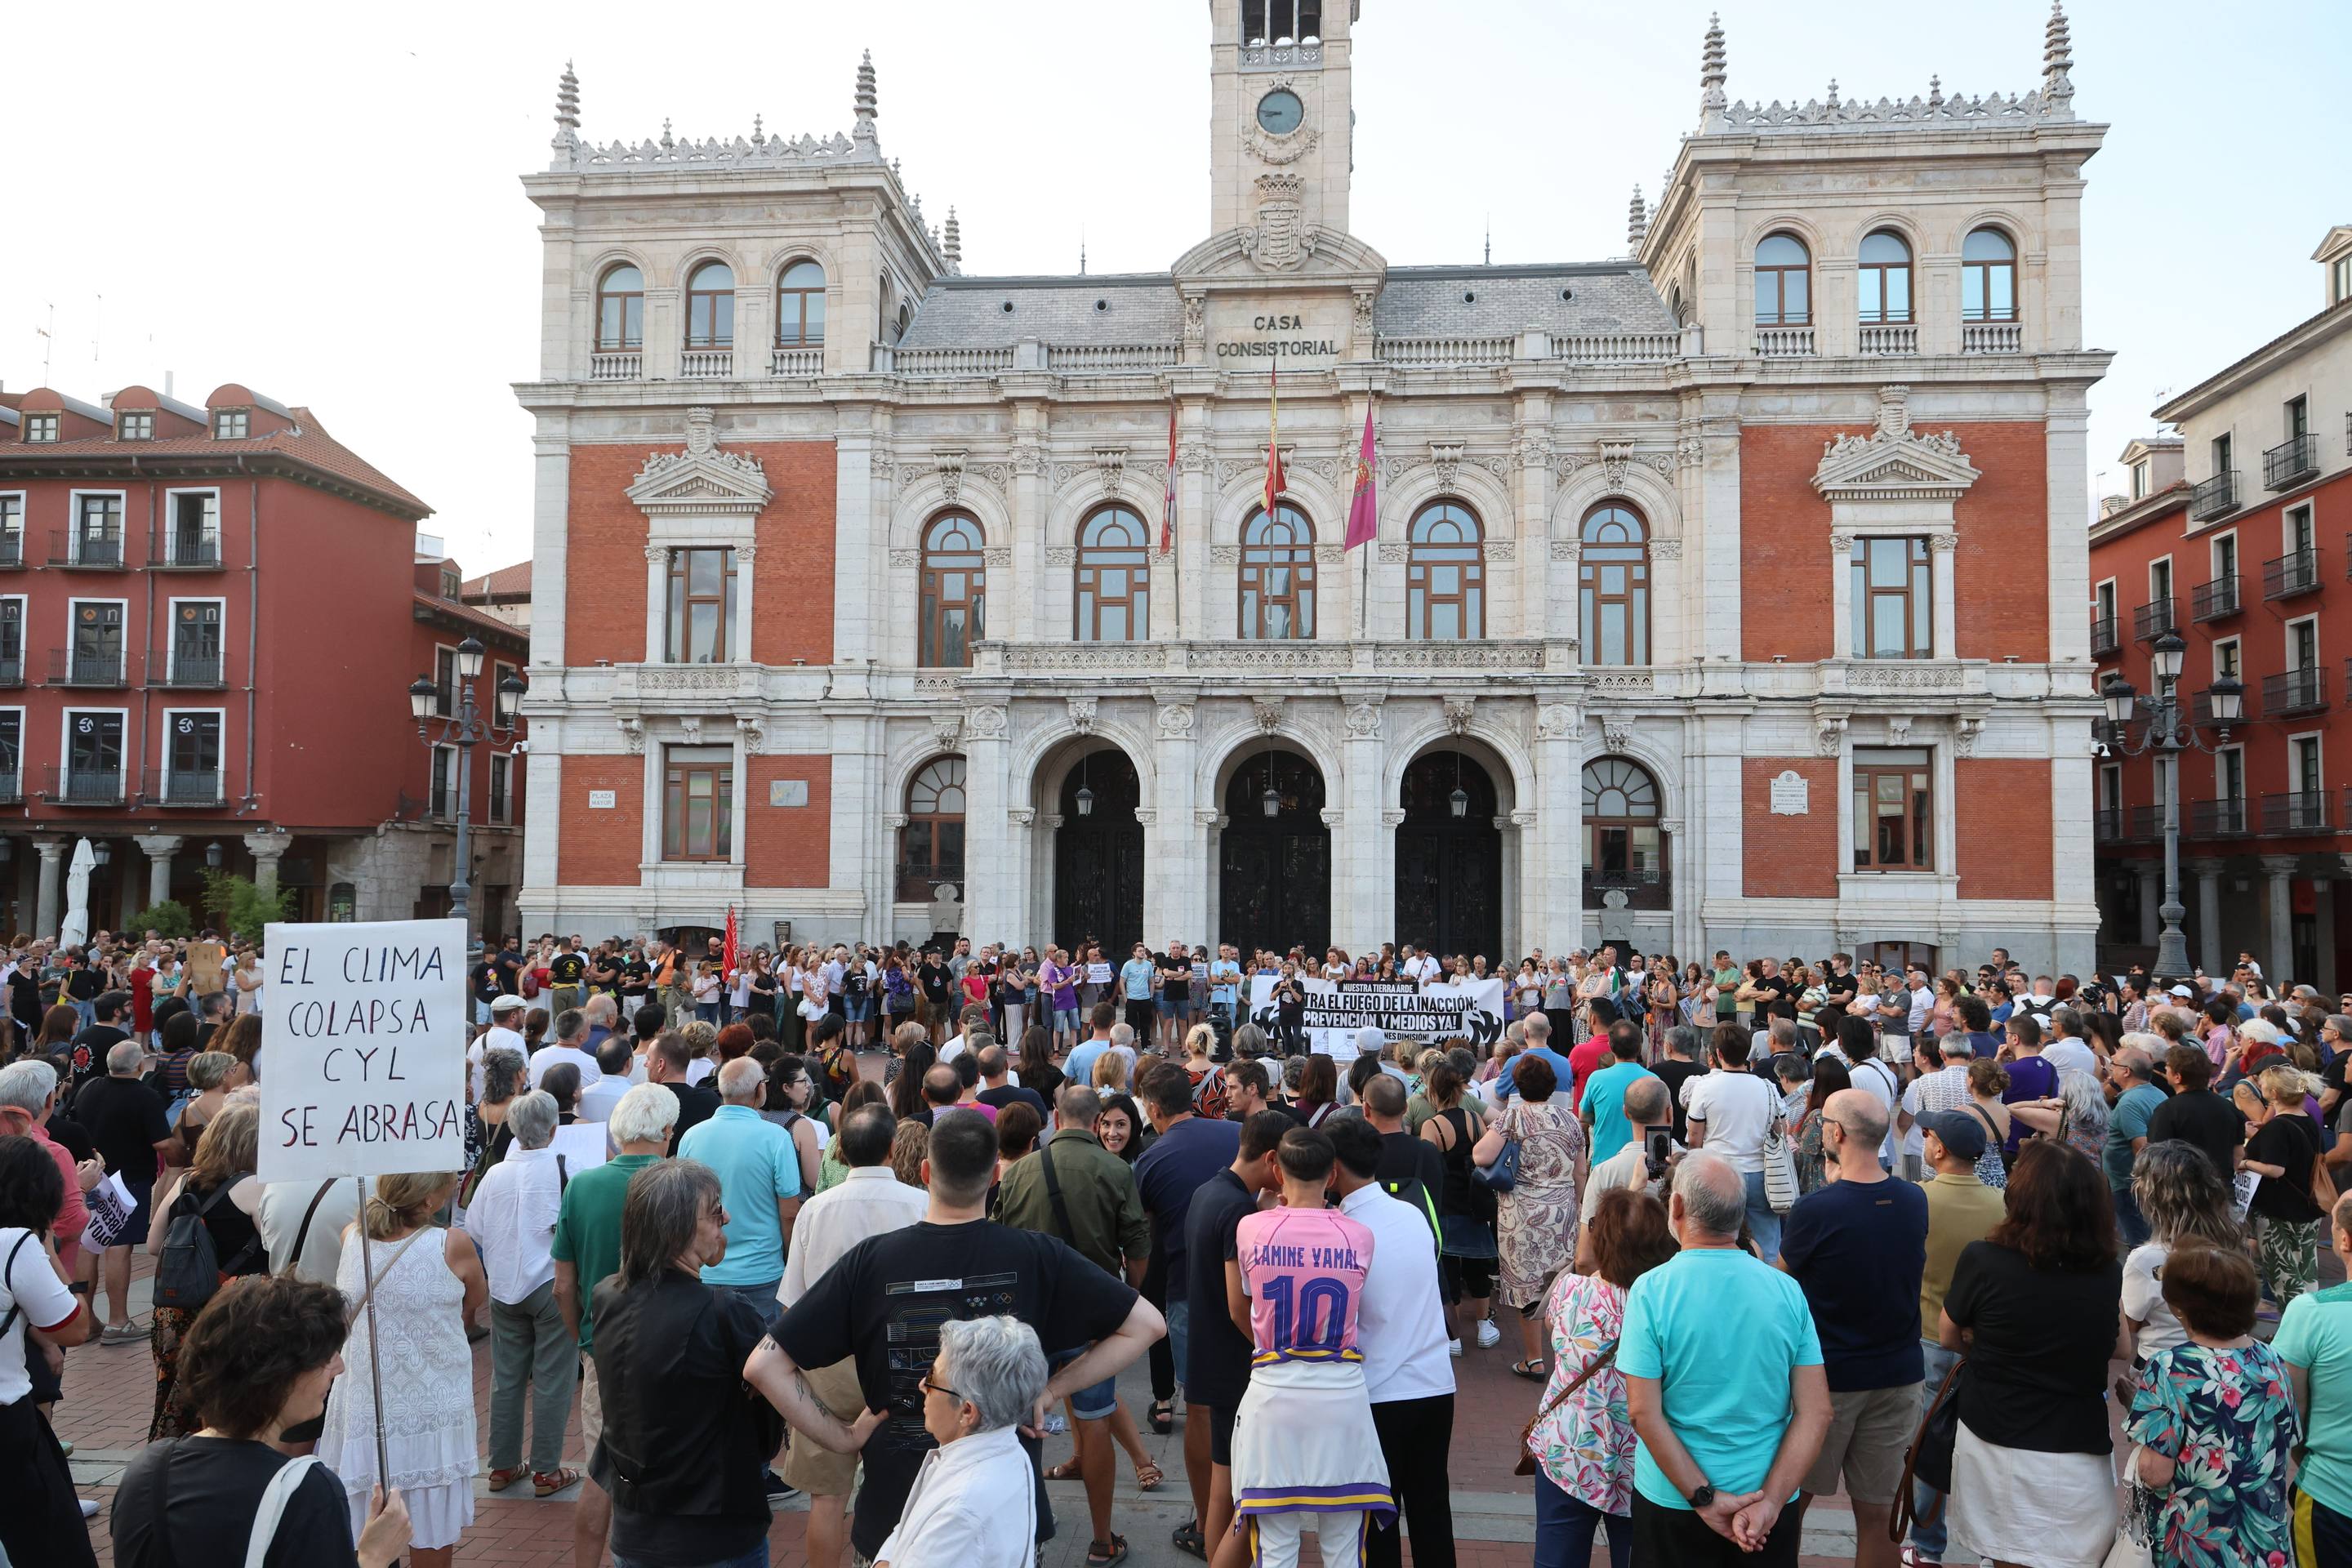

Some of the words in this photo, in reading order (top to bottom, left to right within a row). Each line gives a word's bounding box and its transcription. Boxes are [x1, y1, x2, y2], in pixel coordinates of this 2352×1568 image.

[1254, 315, 1303, 330] CASA
[1217, 341, 1339, 357] CONSISTORIAL
[280, 947, 314, 984] EL
[343, 946, 443, 982] CLIMA
[1343, 983, 1373, 993] NUESTRA
[1373, 984, 1396, 993] TIERRA
[1396, 984, 1414, 994] ARDE
[1330, 994, 1342, 1010] EL
[1343, 995, 1380, 1011] FUEGO
[1383, 996, 1397, 1011] DE
[1402, 996, 1414, 1012] LA
[1417, 994, 1477, 1013] INACCIÓN:
[288, 998, 429, 1037] COLAPSA
[1303, 1010, 1376, 1028] PREVENCIÓN
[1381, 1013, 1390, 1029] Y
[1390, 1013, 1439, 1031] MEDIOS
[1439, 1015, 1457, 1031] YA!
[1397, 1031, 1429, 1041] DIMISIÓN!
[323, 1046, 405, 1082] CYL
[282, 1106, 318, 1147] SE
[337, 1099, 460, 1145] ABRASA
[1254, 1245, 1304, 1267] LAMINE
[1312, 1247, 1360, 1270] YAMAL
[1262, 1275, 1349, 1352] 10
